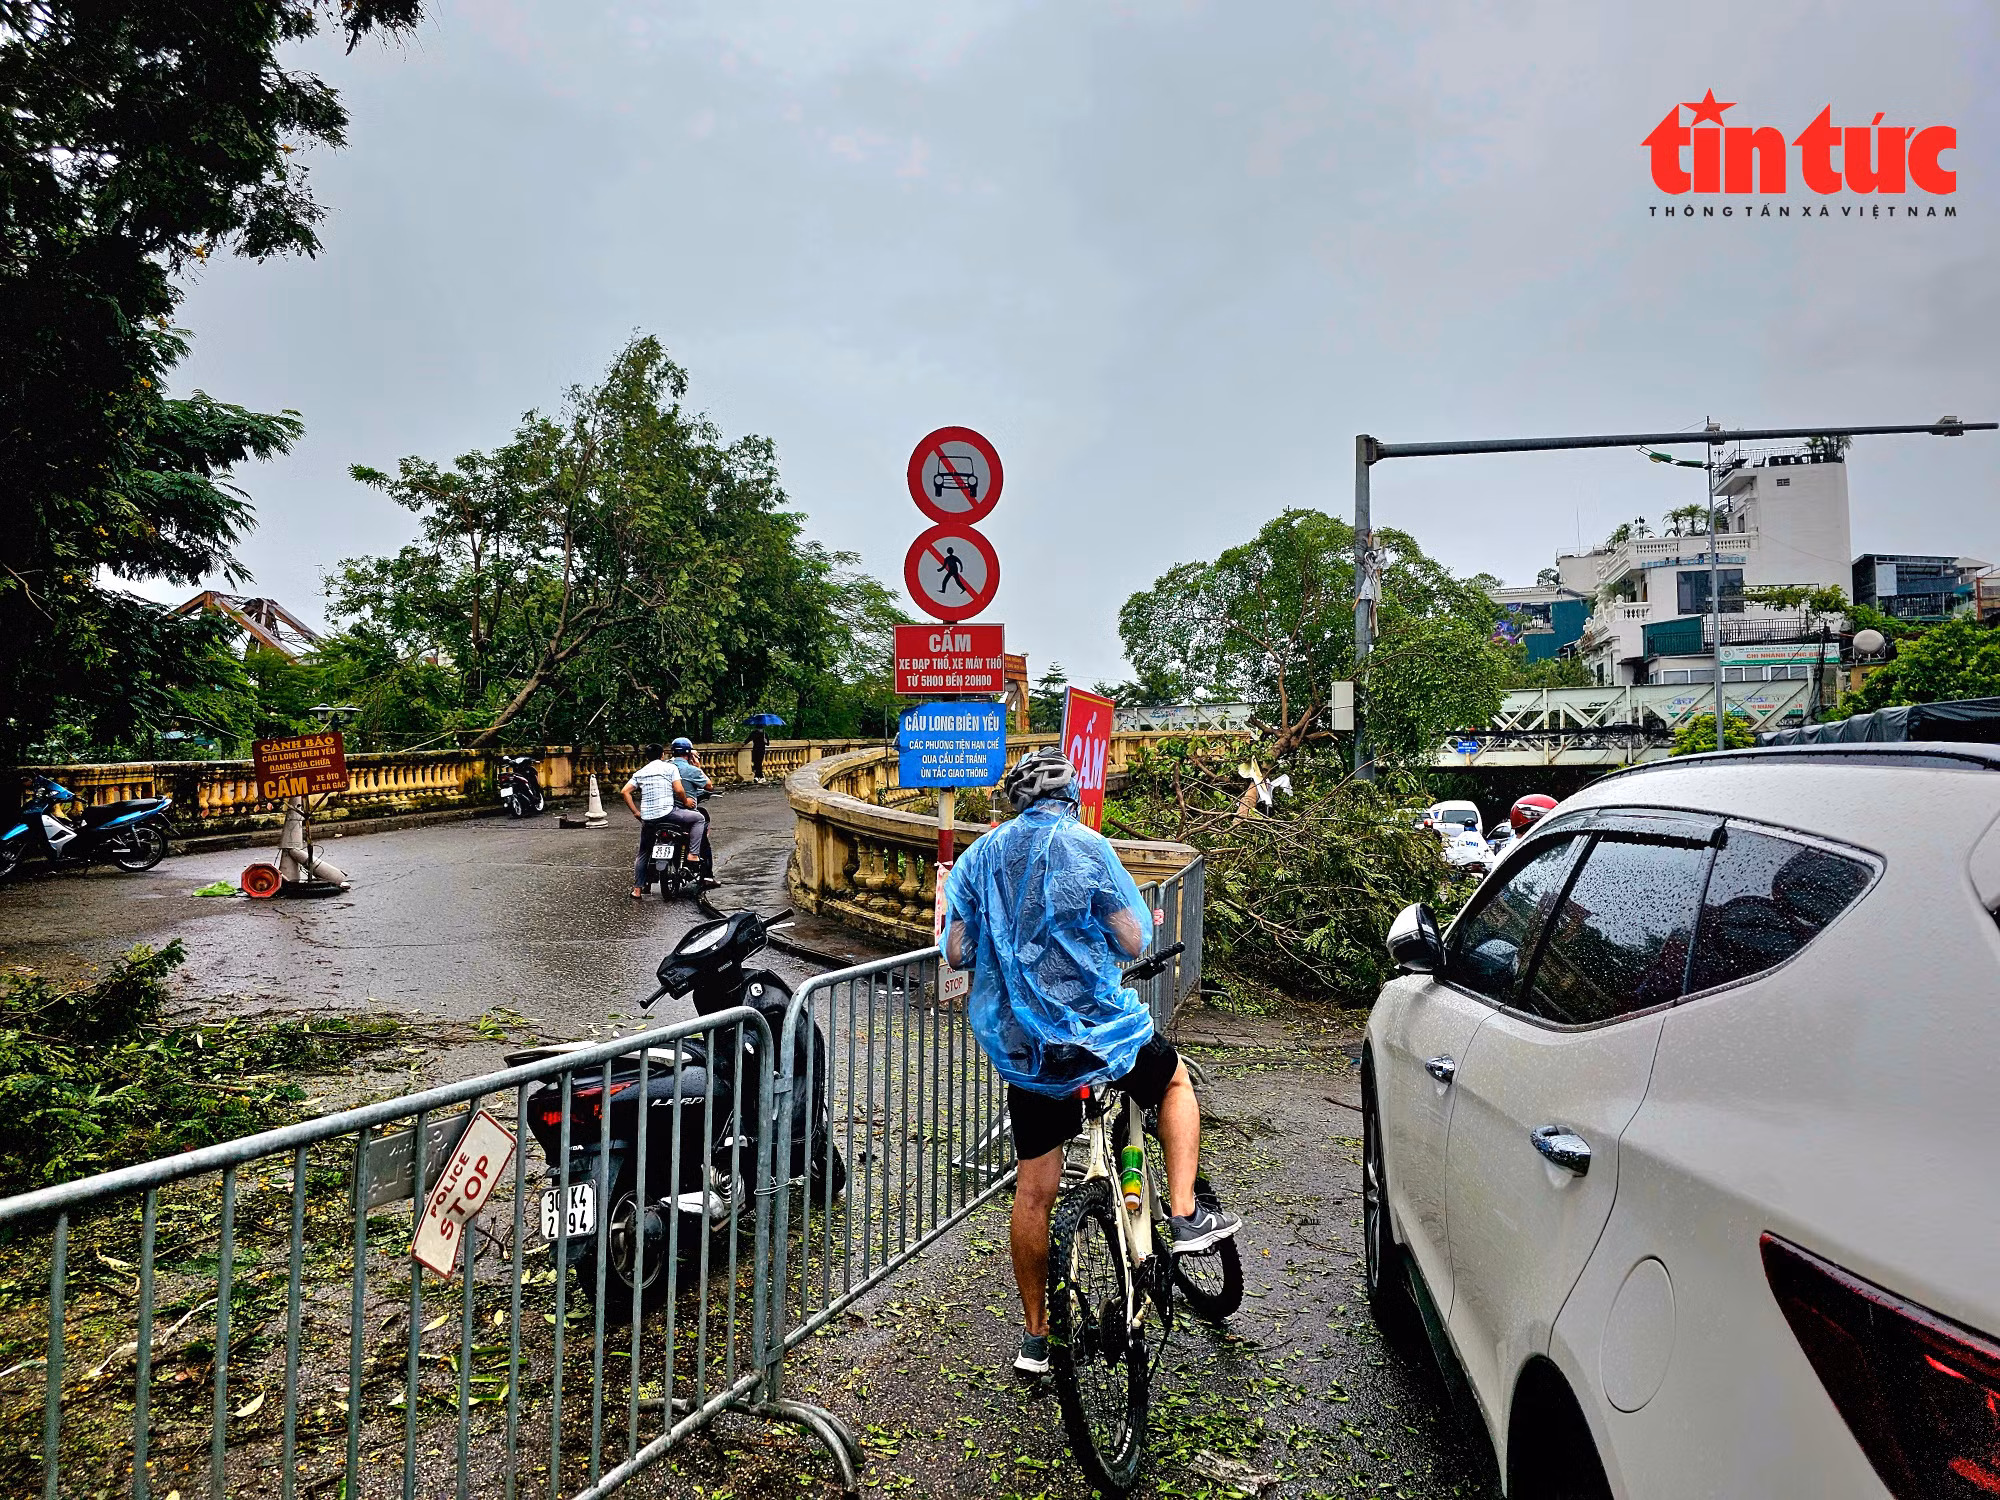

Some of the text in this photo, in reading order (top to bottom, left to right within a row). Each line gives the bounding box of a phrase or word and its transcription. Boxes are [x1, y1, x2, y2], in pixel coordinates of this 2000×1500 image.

[929, 626, 972, 653] CẤM
[899, 658, 910, 670] XE
[912, 658, 930, 672] ĐẠP
[952, 658, 963, 670] XE
[966, 655, 983, 670] MÁY
[906, 671, 992, 687] TỪ 5H00 ĐẾN 20H00
[905, 711, 999, 731] CẦU LONG BIÊN YẾU
[909, 737, 1000, 751] CÁC PHƯƠNG TIỆN HẠN CHẾ
[1070, 711, 1106, 790] CẤM
[279, 752, 300, 761] LONG
[302, 749, 320, 758] BIÊN
[922, 754, 936, 764] QUA
[965, 753, 987, 764] TRÁNH
[948, 769, 965, 778] GIAO
[965, 767, 988, 778] THÔNG
[263, 773, 309, 799] CẤM
[944, 976, 964, 993] STOP
[430, 1151, 470, 1219] POLICE
[440, 1155, 489, 1241] STOP
[547, 1209, 587, 1238] 294
